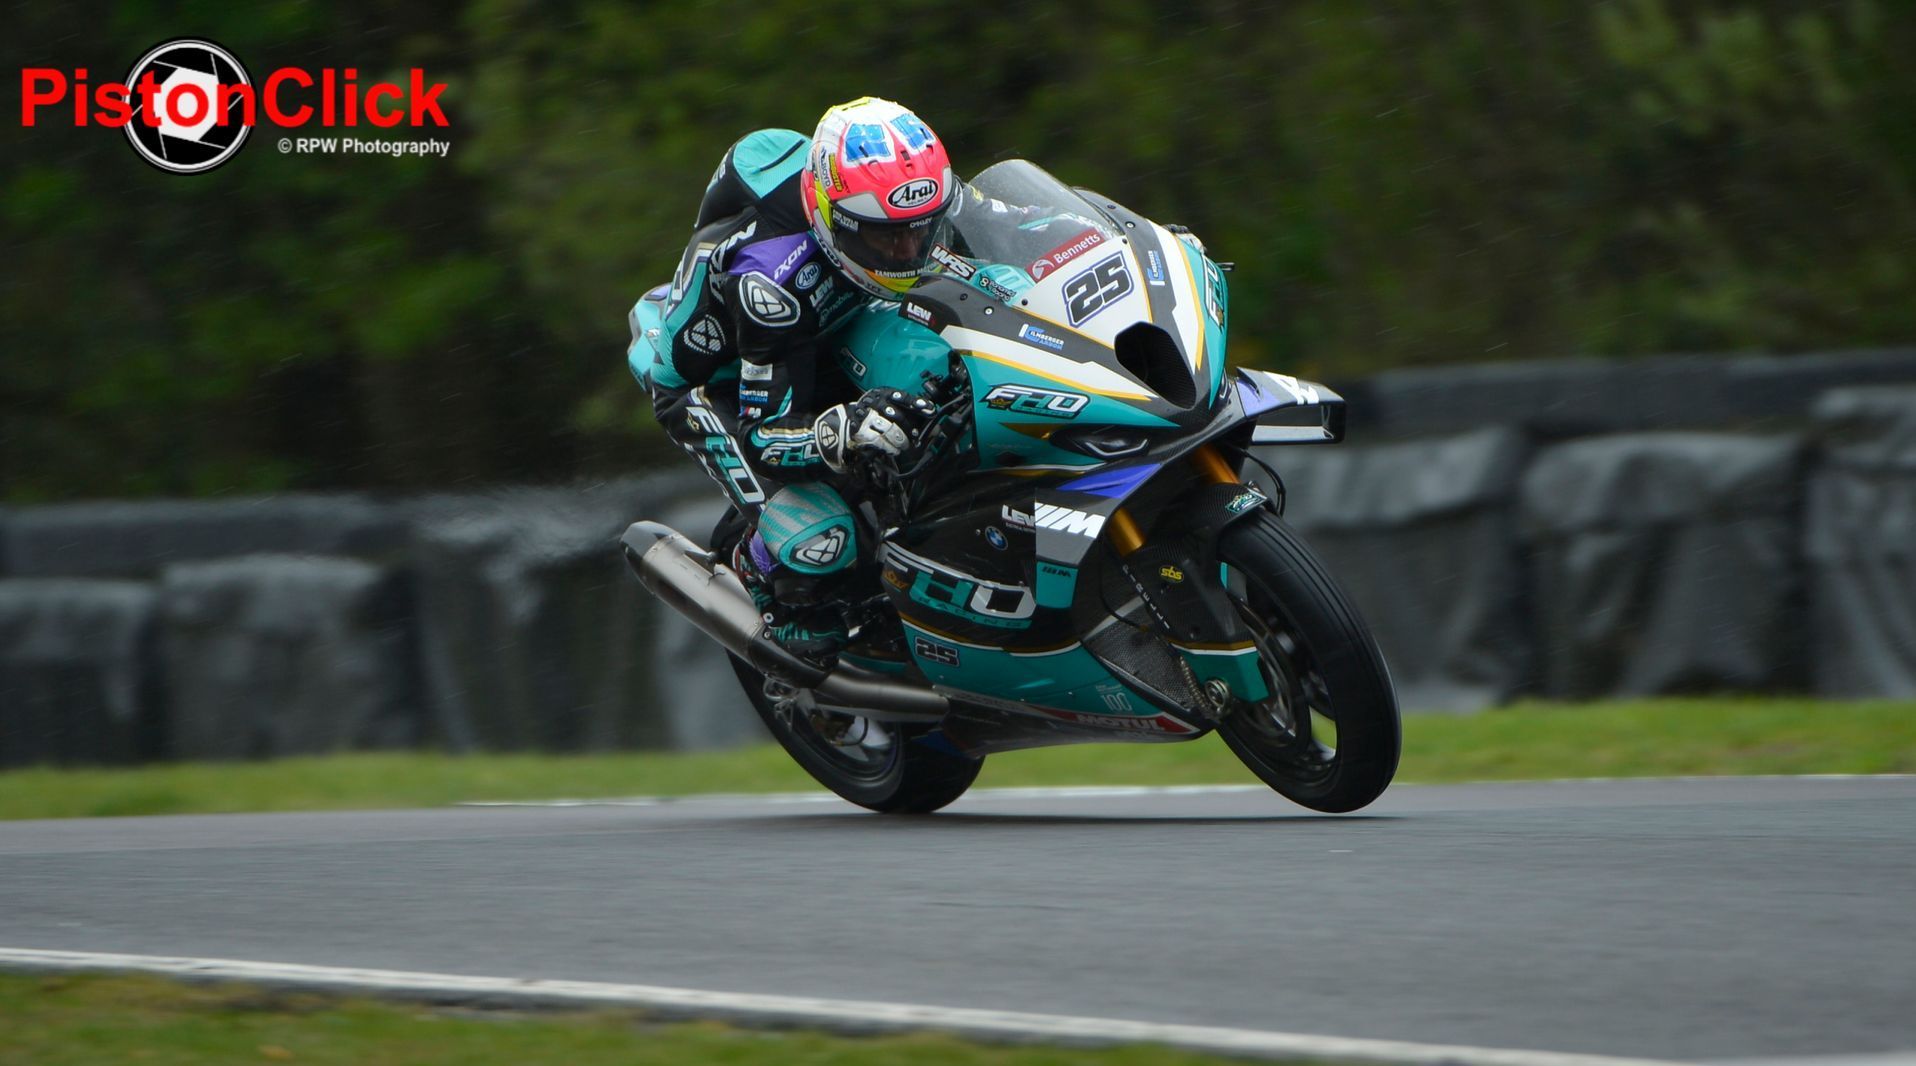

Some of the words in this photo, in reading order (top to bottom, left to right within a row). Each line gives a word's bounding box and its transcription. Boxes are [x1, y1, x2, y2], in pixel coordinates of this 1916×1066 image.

[893, 180, 934, 205] Arai
[774, 239, 808, 280] IXON
[1053, 233, 1101, 265] Bennetts
[799, 263, 818, 287] Arai
[1064, 254, 1132, 324] 25
[809, 275, 834, 308] LEW
[907, 301, 932, 321] LEW
[984, 384, 1089, 414] FHO
[1161, 566, 1183, 581] sbs
[1122, 564, 1170, 630] PIRELLI
[915, 637, 959, 667] 25
[1076, 712, 1165, 731] MOTUL
